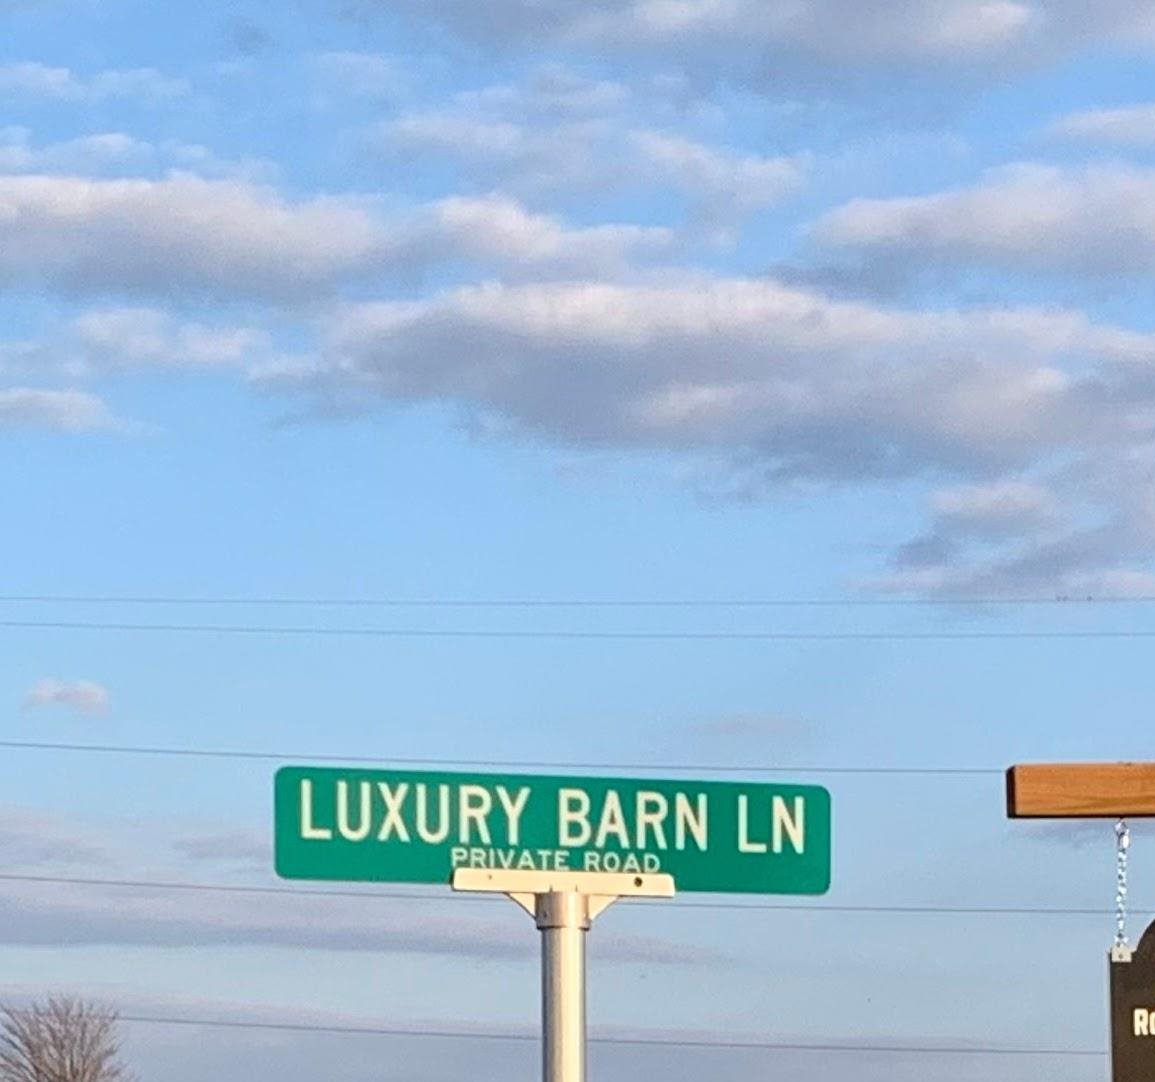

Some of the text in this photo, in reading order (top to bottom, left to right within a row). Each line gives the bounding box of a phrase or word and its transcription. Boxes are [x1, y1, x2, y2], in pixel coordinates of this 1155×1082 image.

[301, 778, 804, 854] LUXURY BARN LN
[451, 847, 661, 874] PRIVATE ROAD
